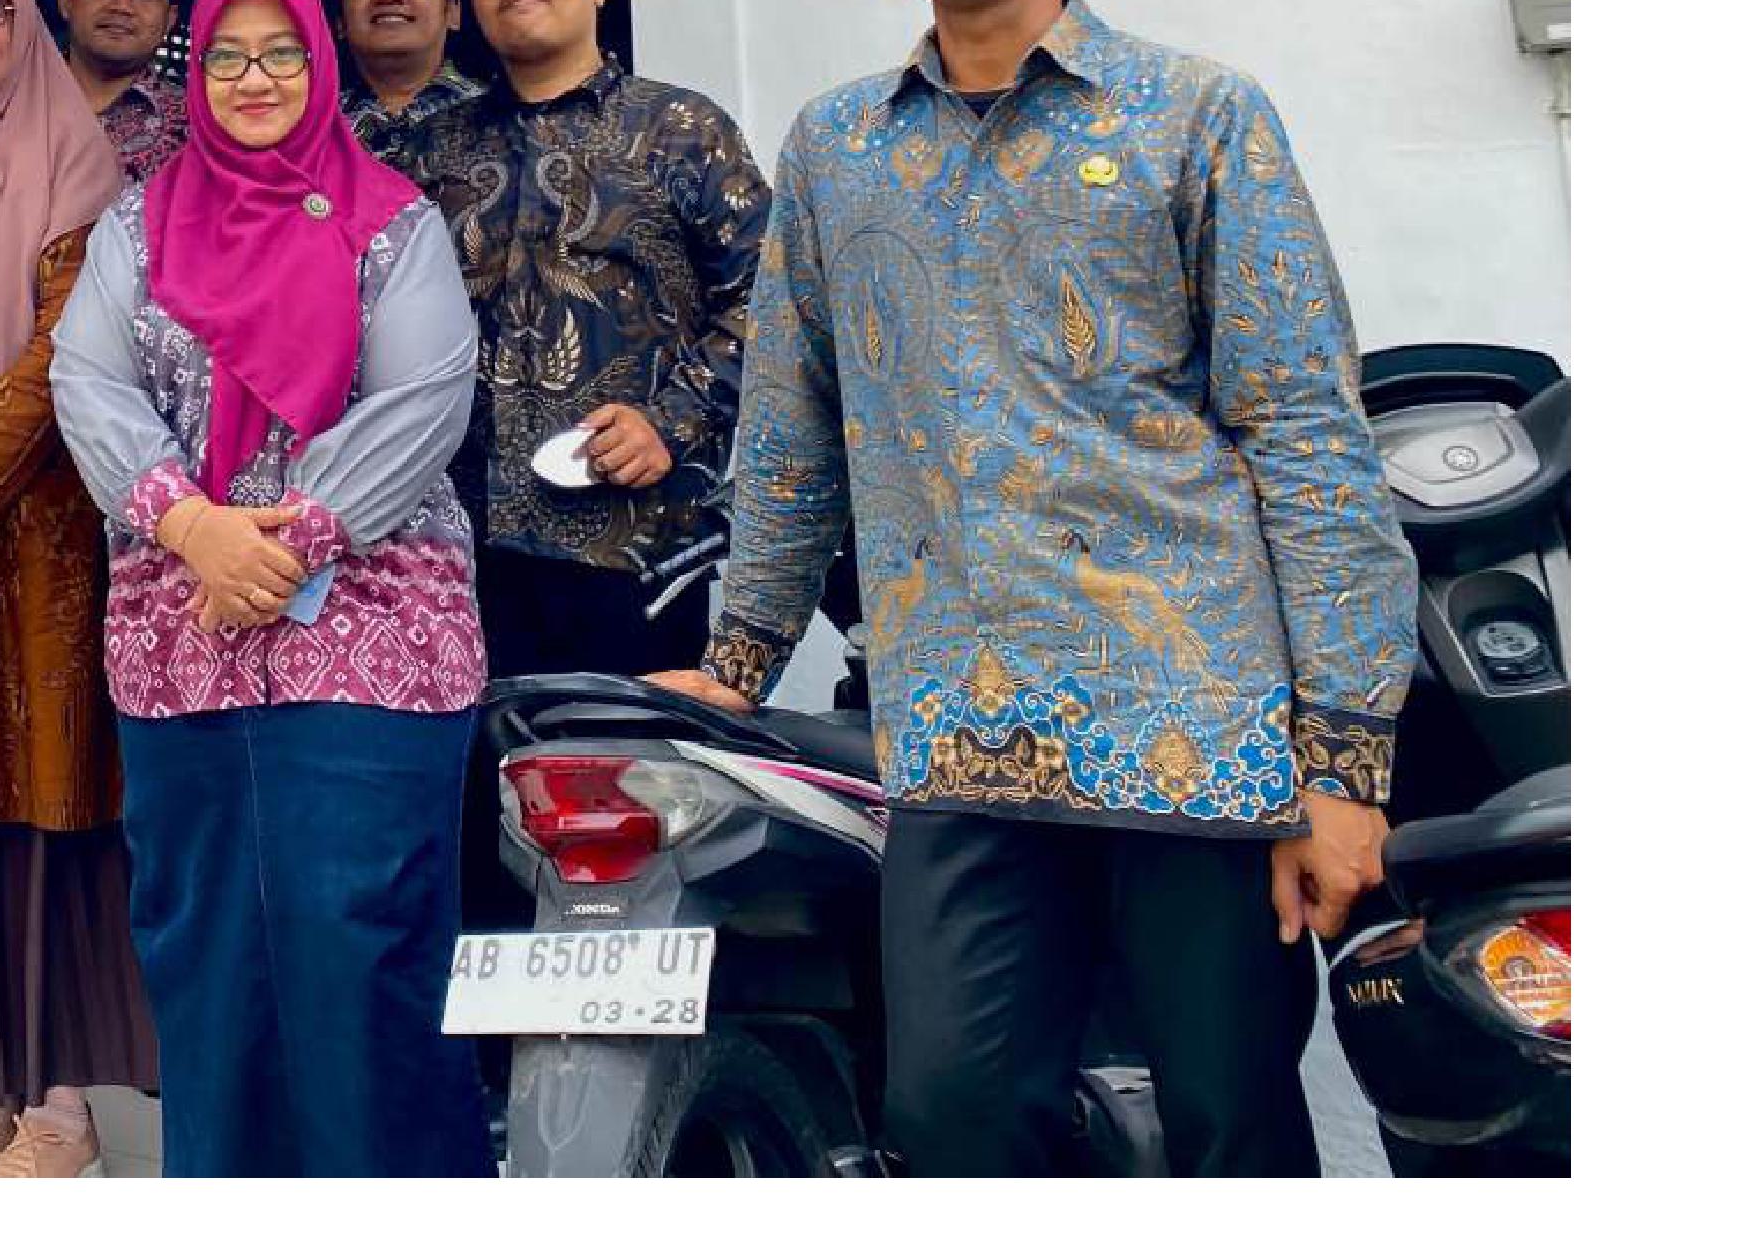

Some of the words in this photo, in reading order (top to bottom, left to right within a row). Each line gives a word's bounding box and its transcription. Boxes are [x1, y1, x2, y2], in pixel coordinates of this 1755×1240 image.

[452, 938, 500, 979] AB
[526, 934, 626, 978] 6508
[657, 931, 710, 976] UT
